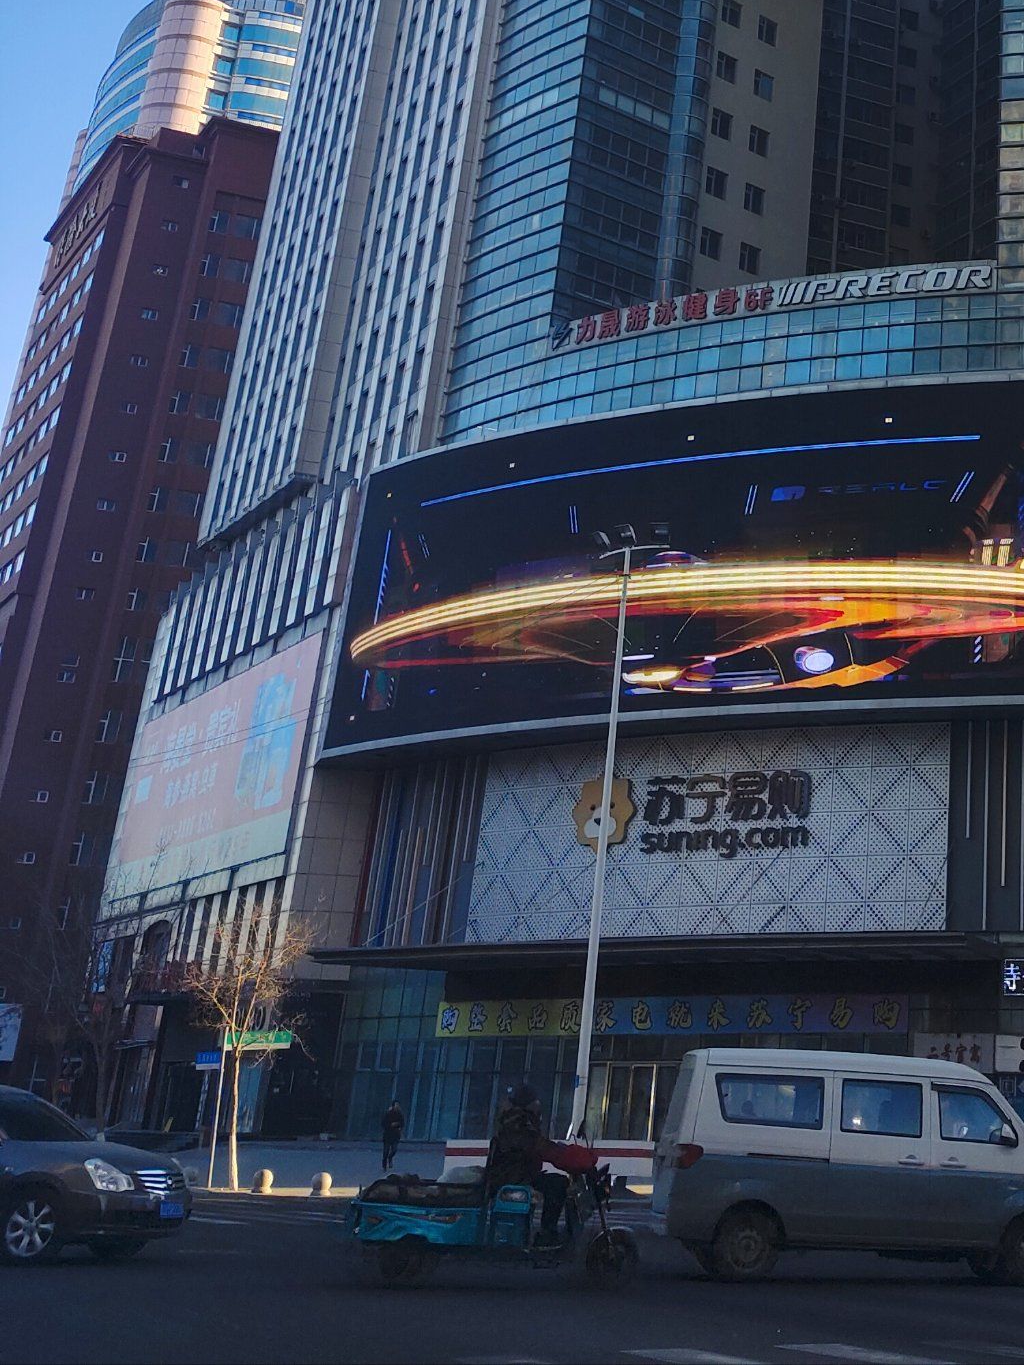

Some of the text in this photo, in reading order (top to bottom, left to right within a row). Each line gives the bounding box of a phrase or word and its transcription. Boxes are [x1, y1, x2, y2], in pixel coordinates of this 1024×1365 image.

[803, 265, 992, 305] PRECOR
[643, 770, 812, 826] 苏宁易购
[640, 826, 810, 858] suning.com
